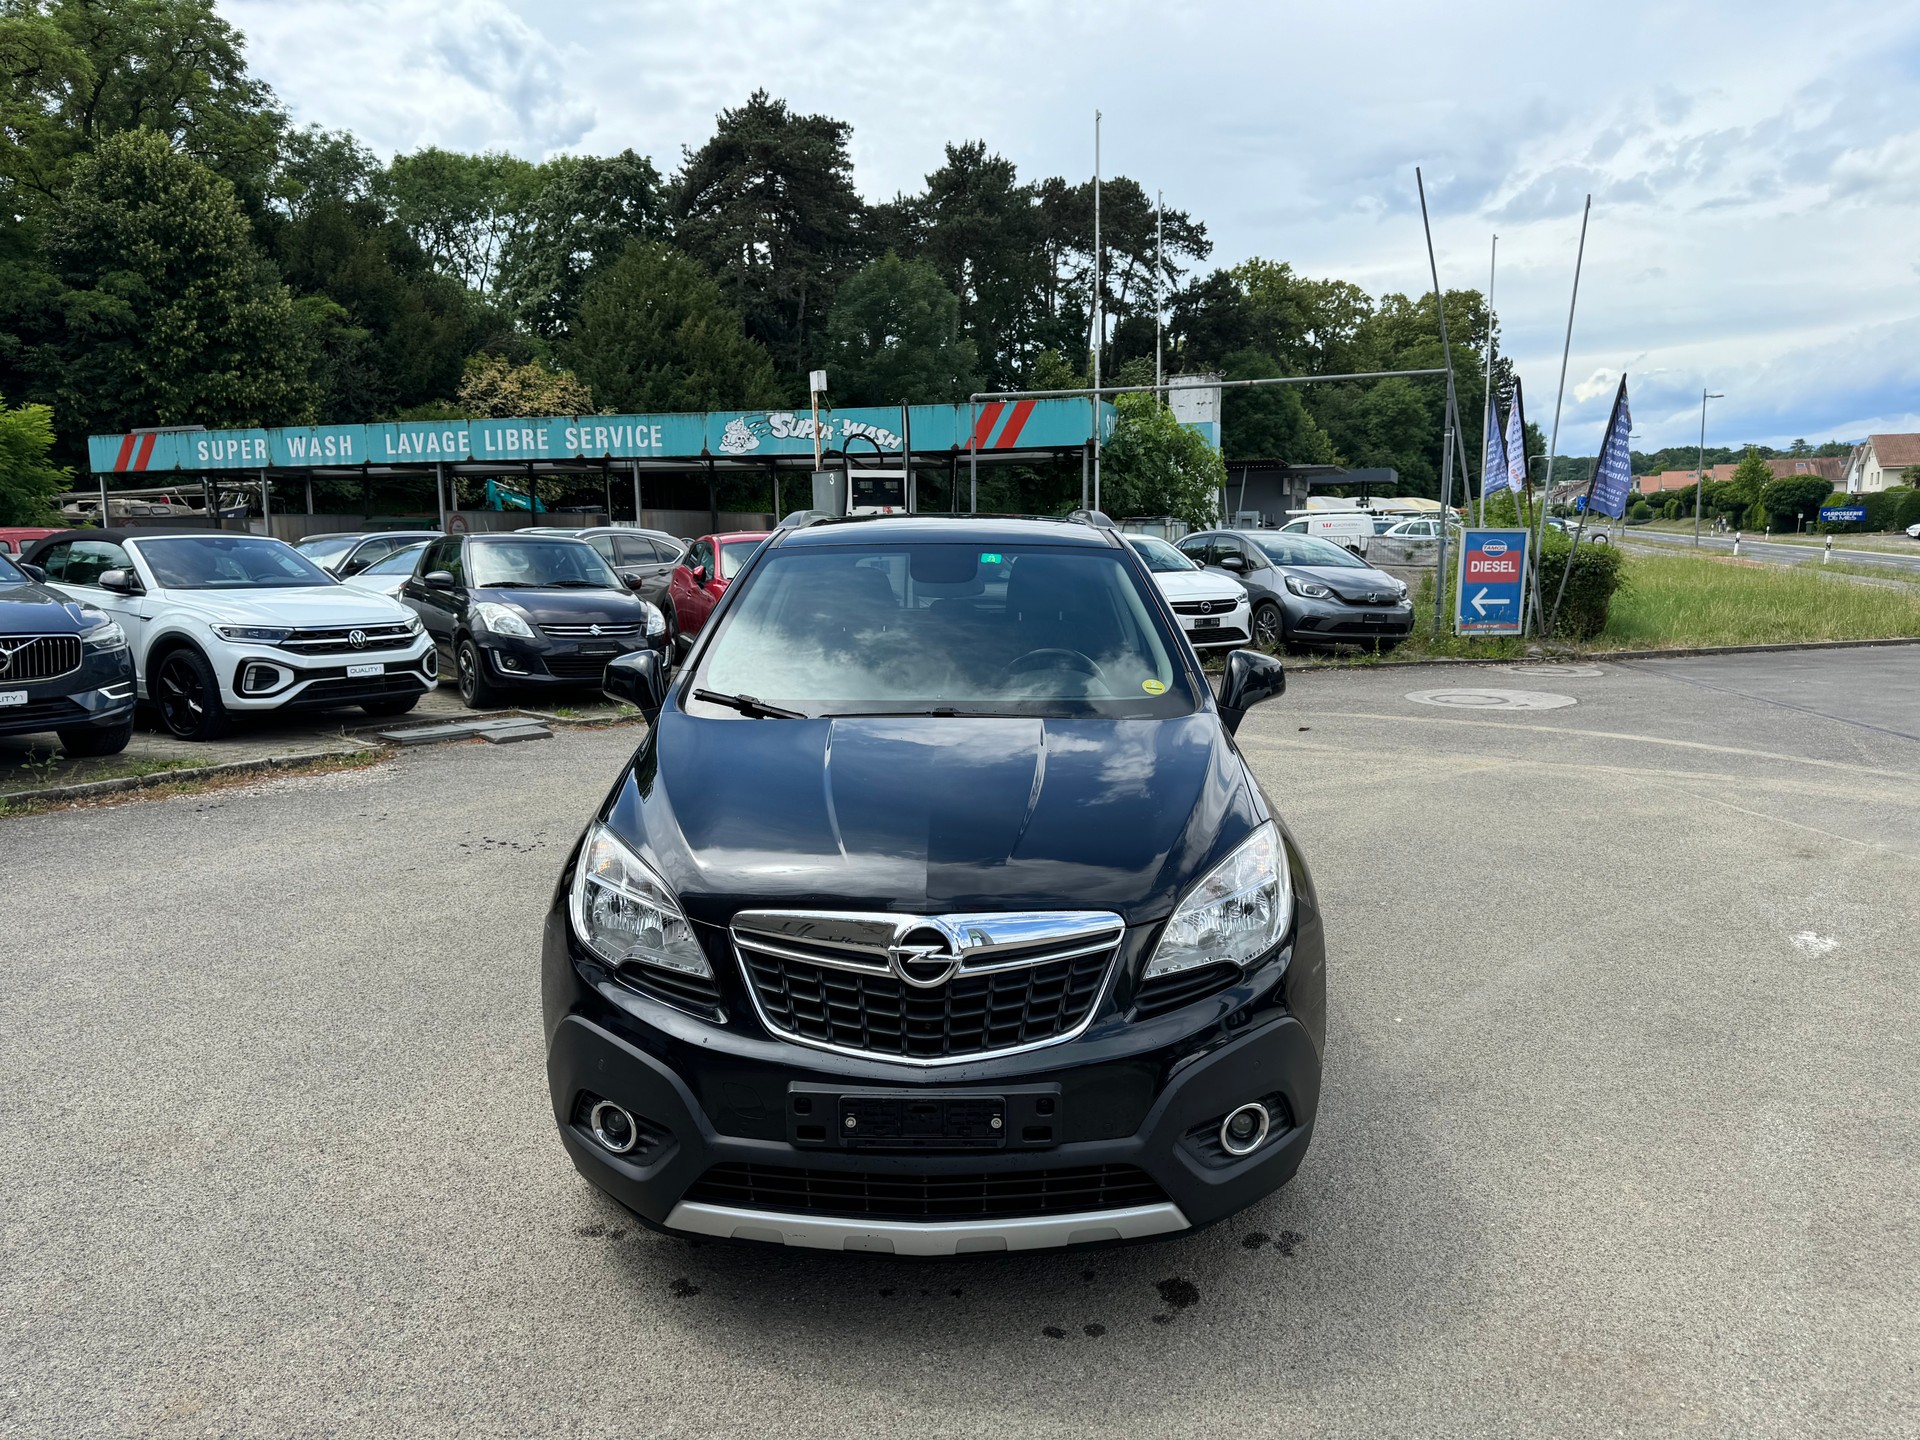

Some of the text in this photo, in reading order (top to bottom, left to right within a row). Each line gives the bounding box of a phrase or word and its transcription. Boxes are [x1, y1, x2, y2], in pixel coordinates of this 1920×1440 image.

[769, 412, 903, 450] SUPER WASH
[198, 424, 663, 461] SUPER WASH LAVAGE LIBRE SERVICE
[829, 472, 835, 486] 3
[1470, 560, 1516, 573] DIESEL
[350, 666, 379, 674] QUALITY
